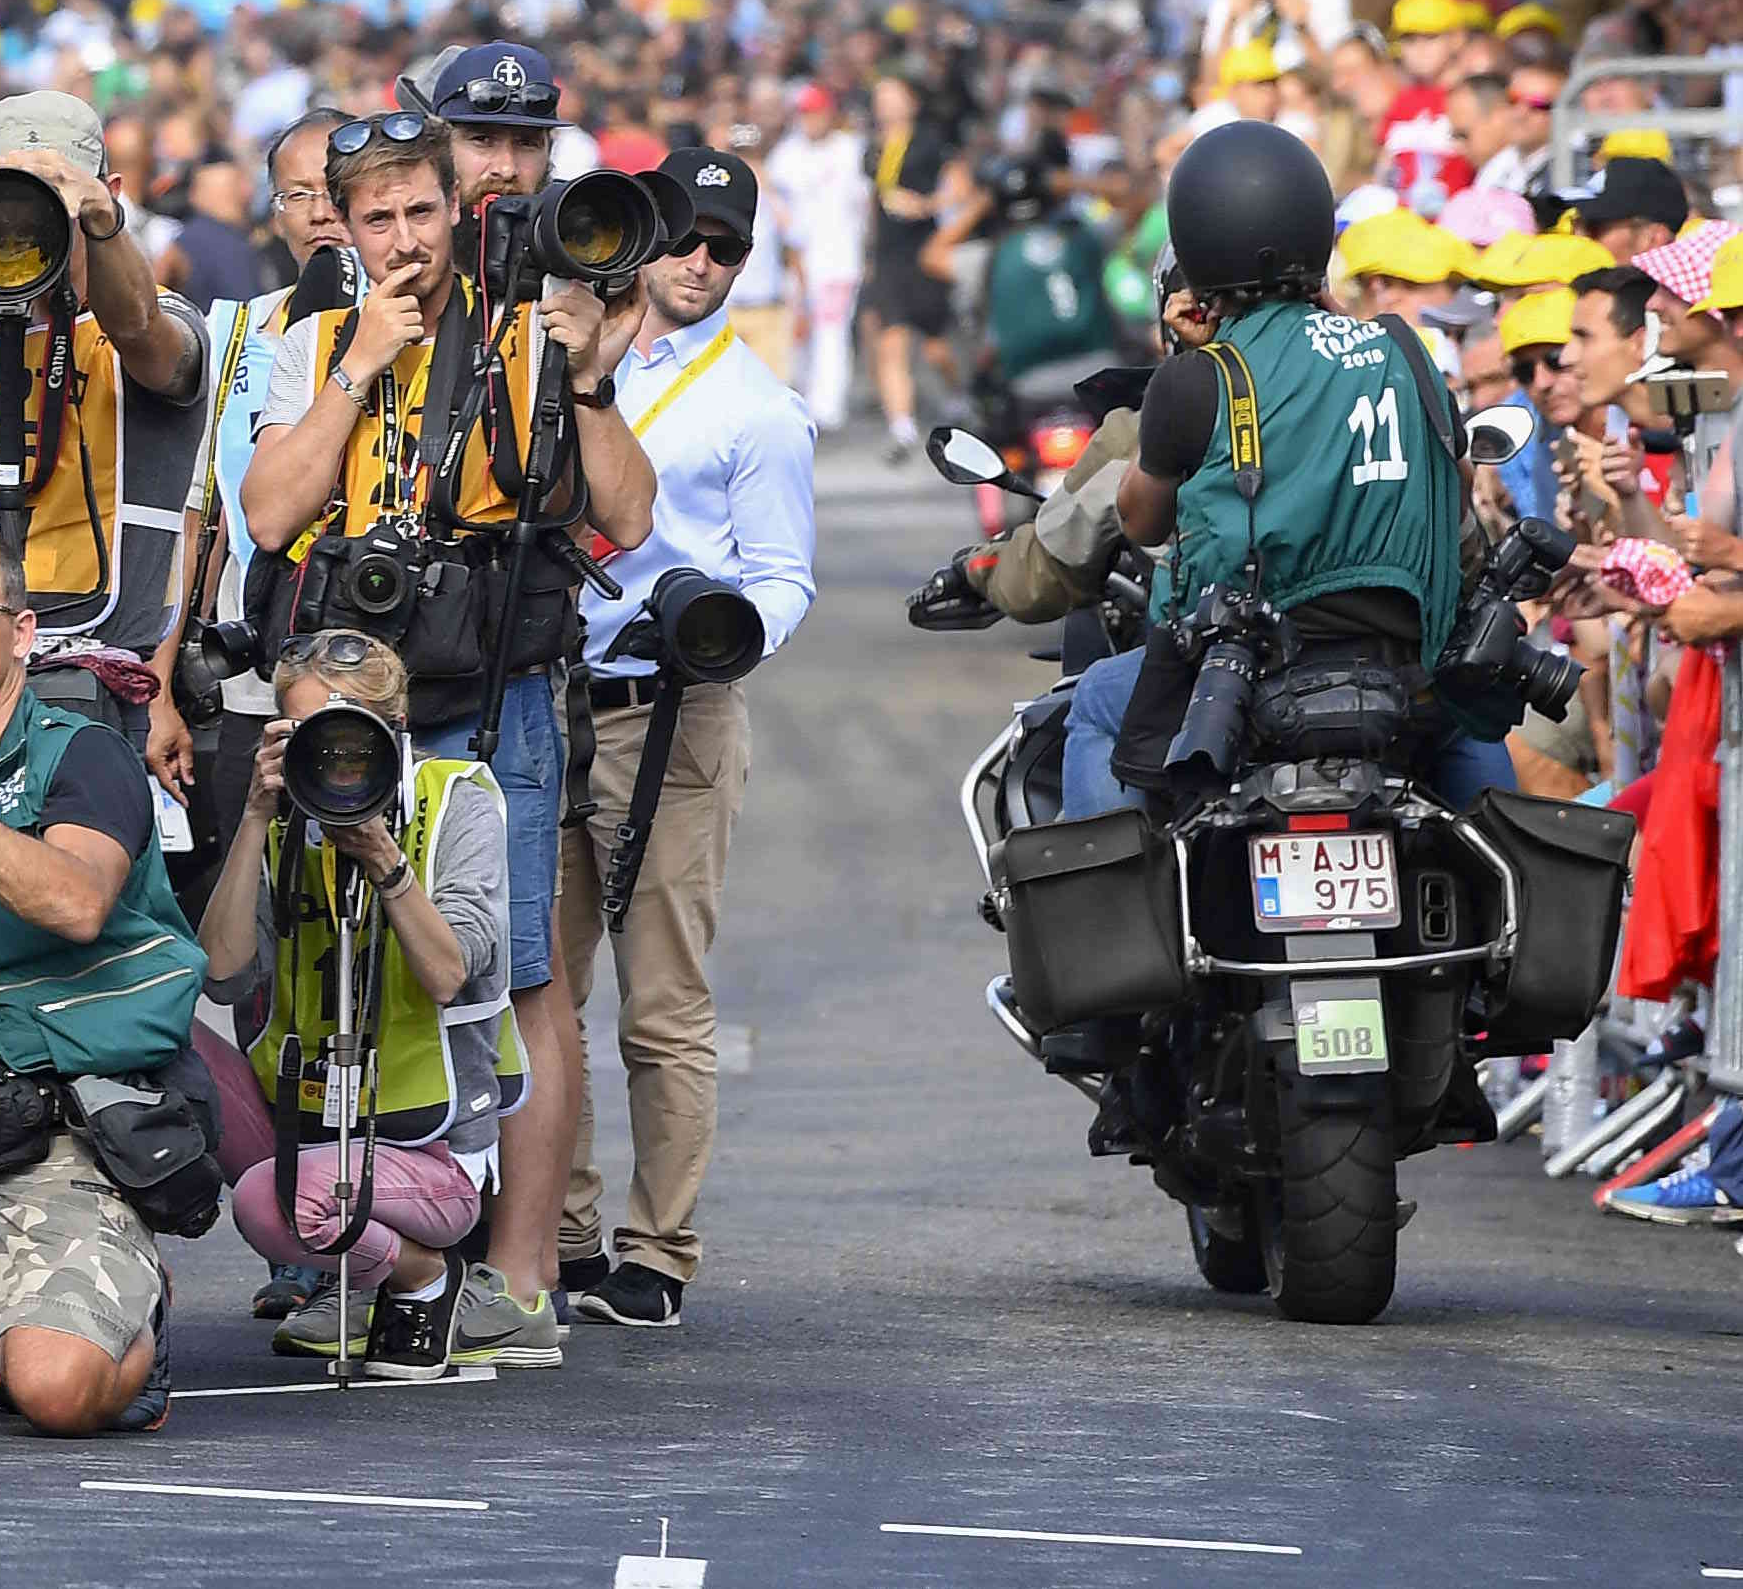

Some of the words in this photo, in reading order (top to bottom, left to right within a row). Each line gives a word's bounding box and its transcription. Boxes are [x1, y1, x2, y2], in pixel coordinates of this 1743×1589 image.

[46, 333, 69, 390] Canon
[233, 352, 250, 396] 201
[1340, 348, 1386, 370] 2018
[438, 430, 463, 478] Canon
[1346, 386, 1411, 487] 11
[1316, 877, 1390, 912] 975
[1312, 1026, 1373, 1062] 508
